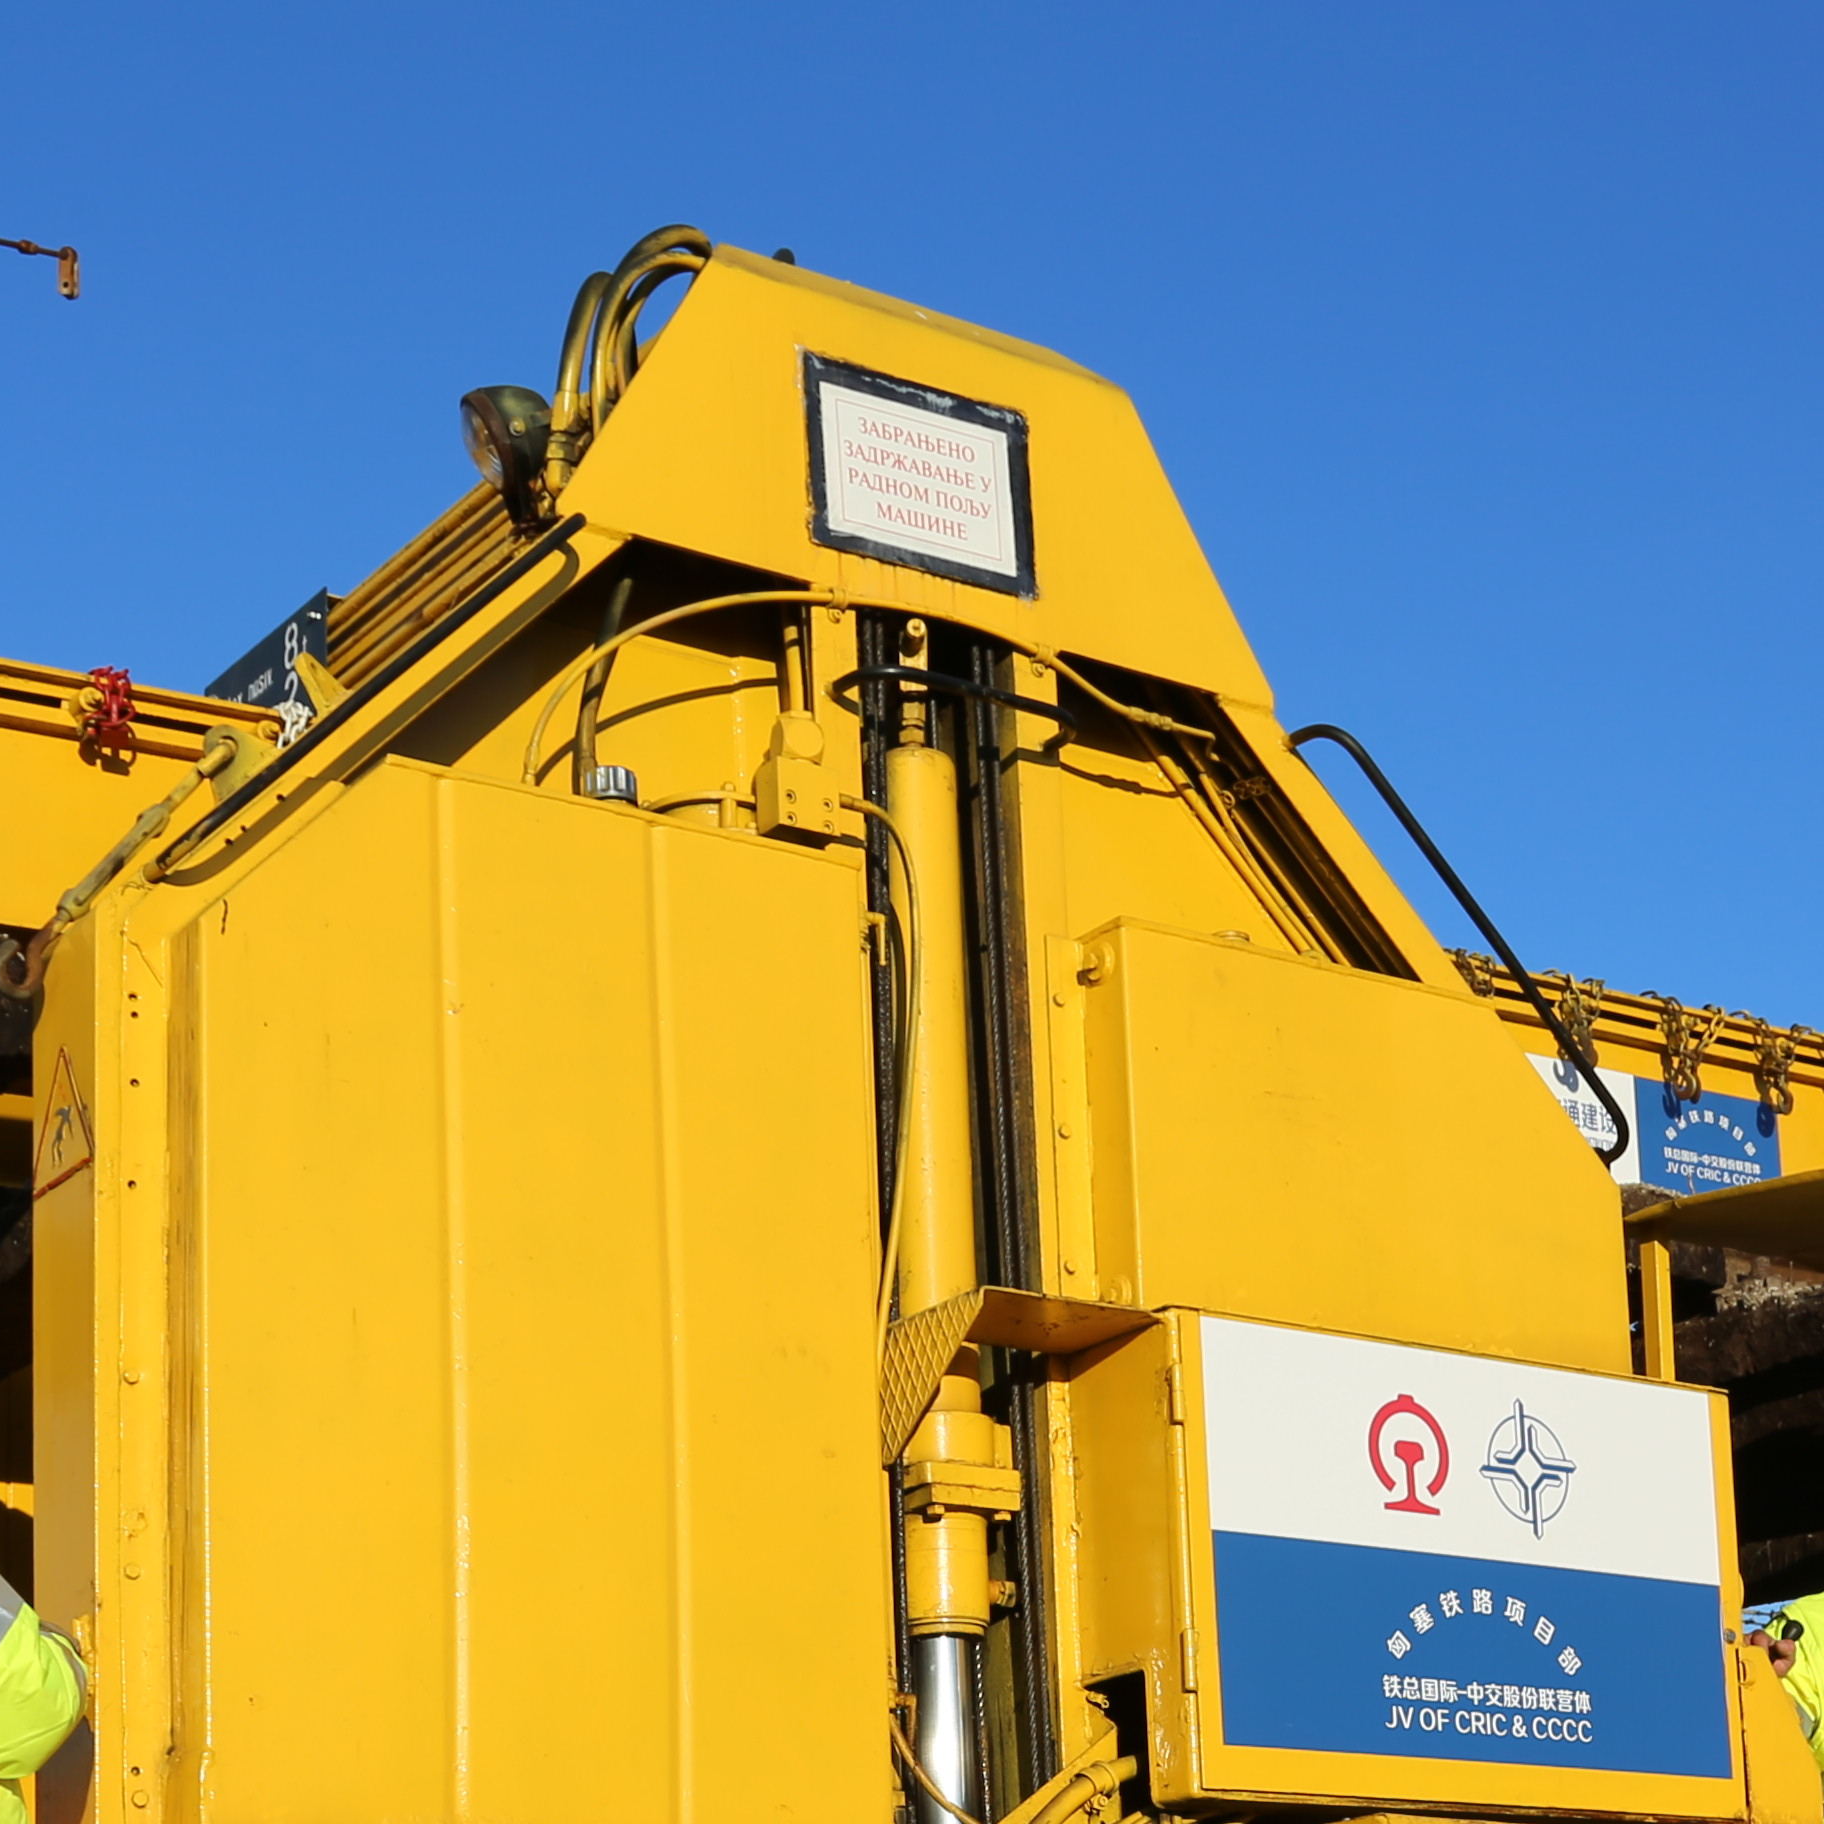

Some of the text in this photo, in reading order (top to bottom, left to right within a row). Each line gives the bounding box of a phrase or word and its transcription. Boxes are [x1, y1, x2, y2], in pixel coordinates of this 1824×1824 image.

[857, 415, 976, 463] ЗАБРАЊЕНО
[843, 439, 992, 493] ЗАДРЖАВАЊЕ У
[847, 467, 992, 520] РАДНОМ ПОЉУ
[876, 501, 968, 541] МАШИНЕ
[1665, 1161, 1679, 1174] JV
[1680, 1164, 1695, 1176] OF
[1696, 1167, 1722, 1182] CRIC
[1723, 1171, 1732, 1184] &
[1387, 1588, 1582, 1676] 匈塞铁路项目部
[1385, 1705, 1593, 1743] JV OF CRIC & CCCC
